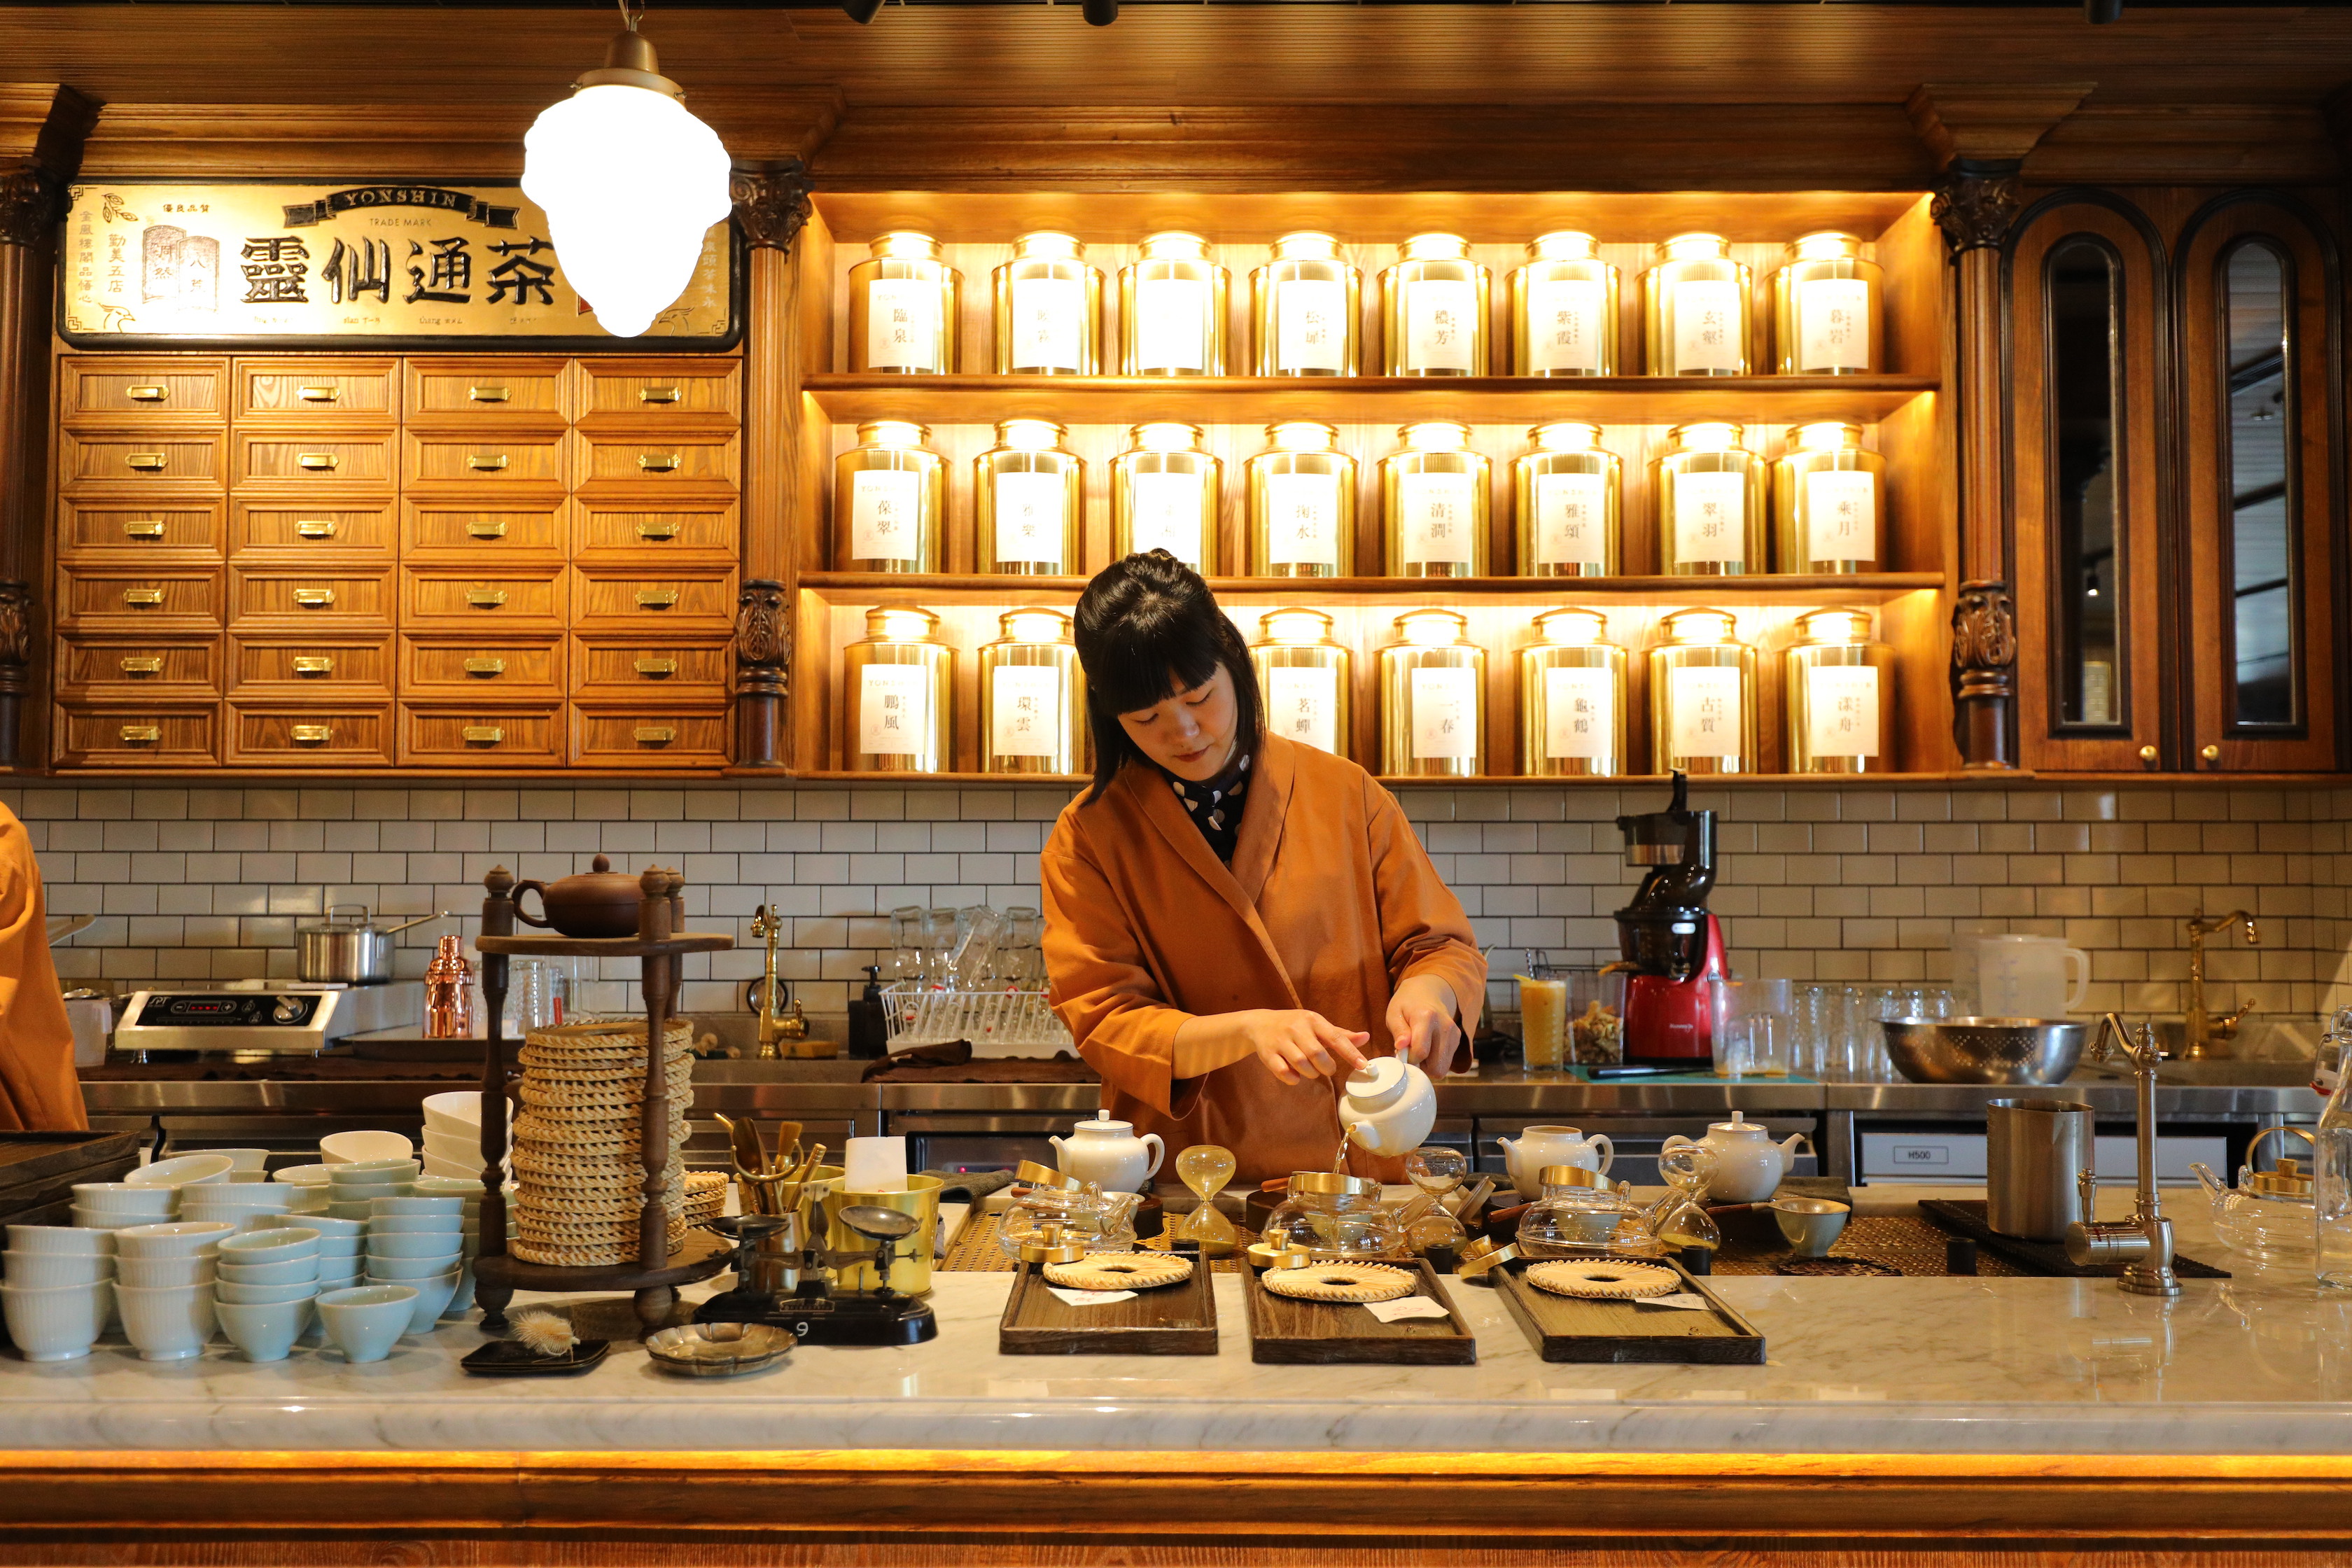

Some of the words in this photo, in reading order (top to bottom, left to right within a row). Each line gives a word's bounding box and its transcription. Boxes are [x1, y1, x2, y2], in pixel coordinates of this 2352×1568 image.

[345, 188, 458, 207] YONSHIN
[370, 218, 400, 226] TRADE
[403, 218, 432, 227] MARK
[239, 234, 556, 305] 靈仙通茶
[893, 309, 907, 343] 臨泉
[1557, 310, 1572, 344] 紫霞
[1017, 696, 1031, 732] 環雲
[1908, 1150, 1931, 1160] H500
[797, 1321, 809, 1337] 9
